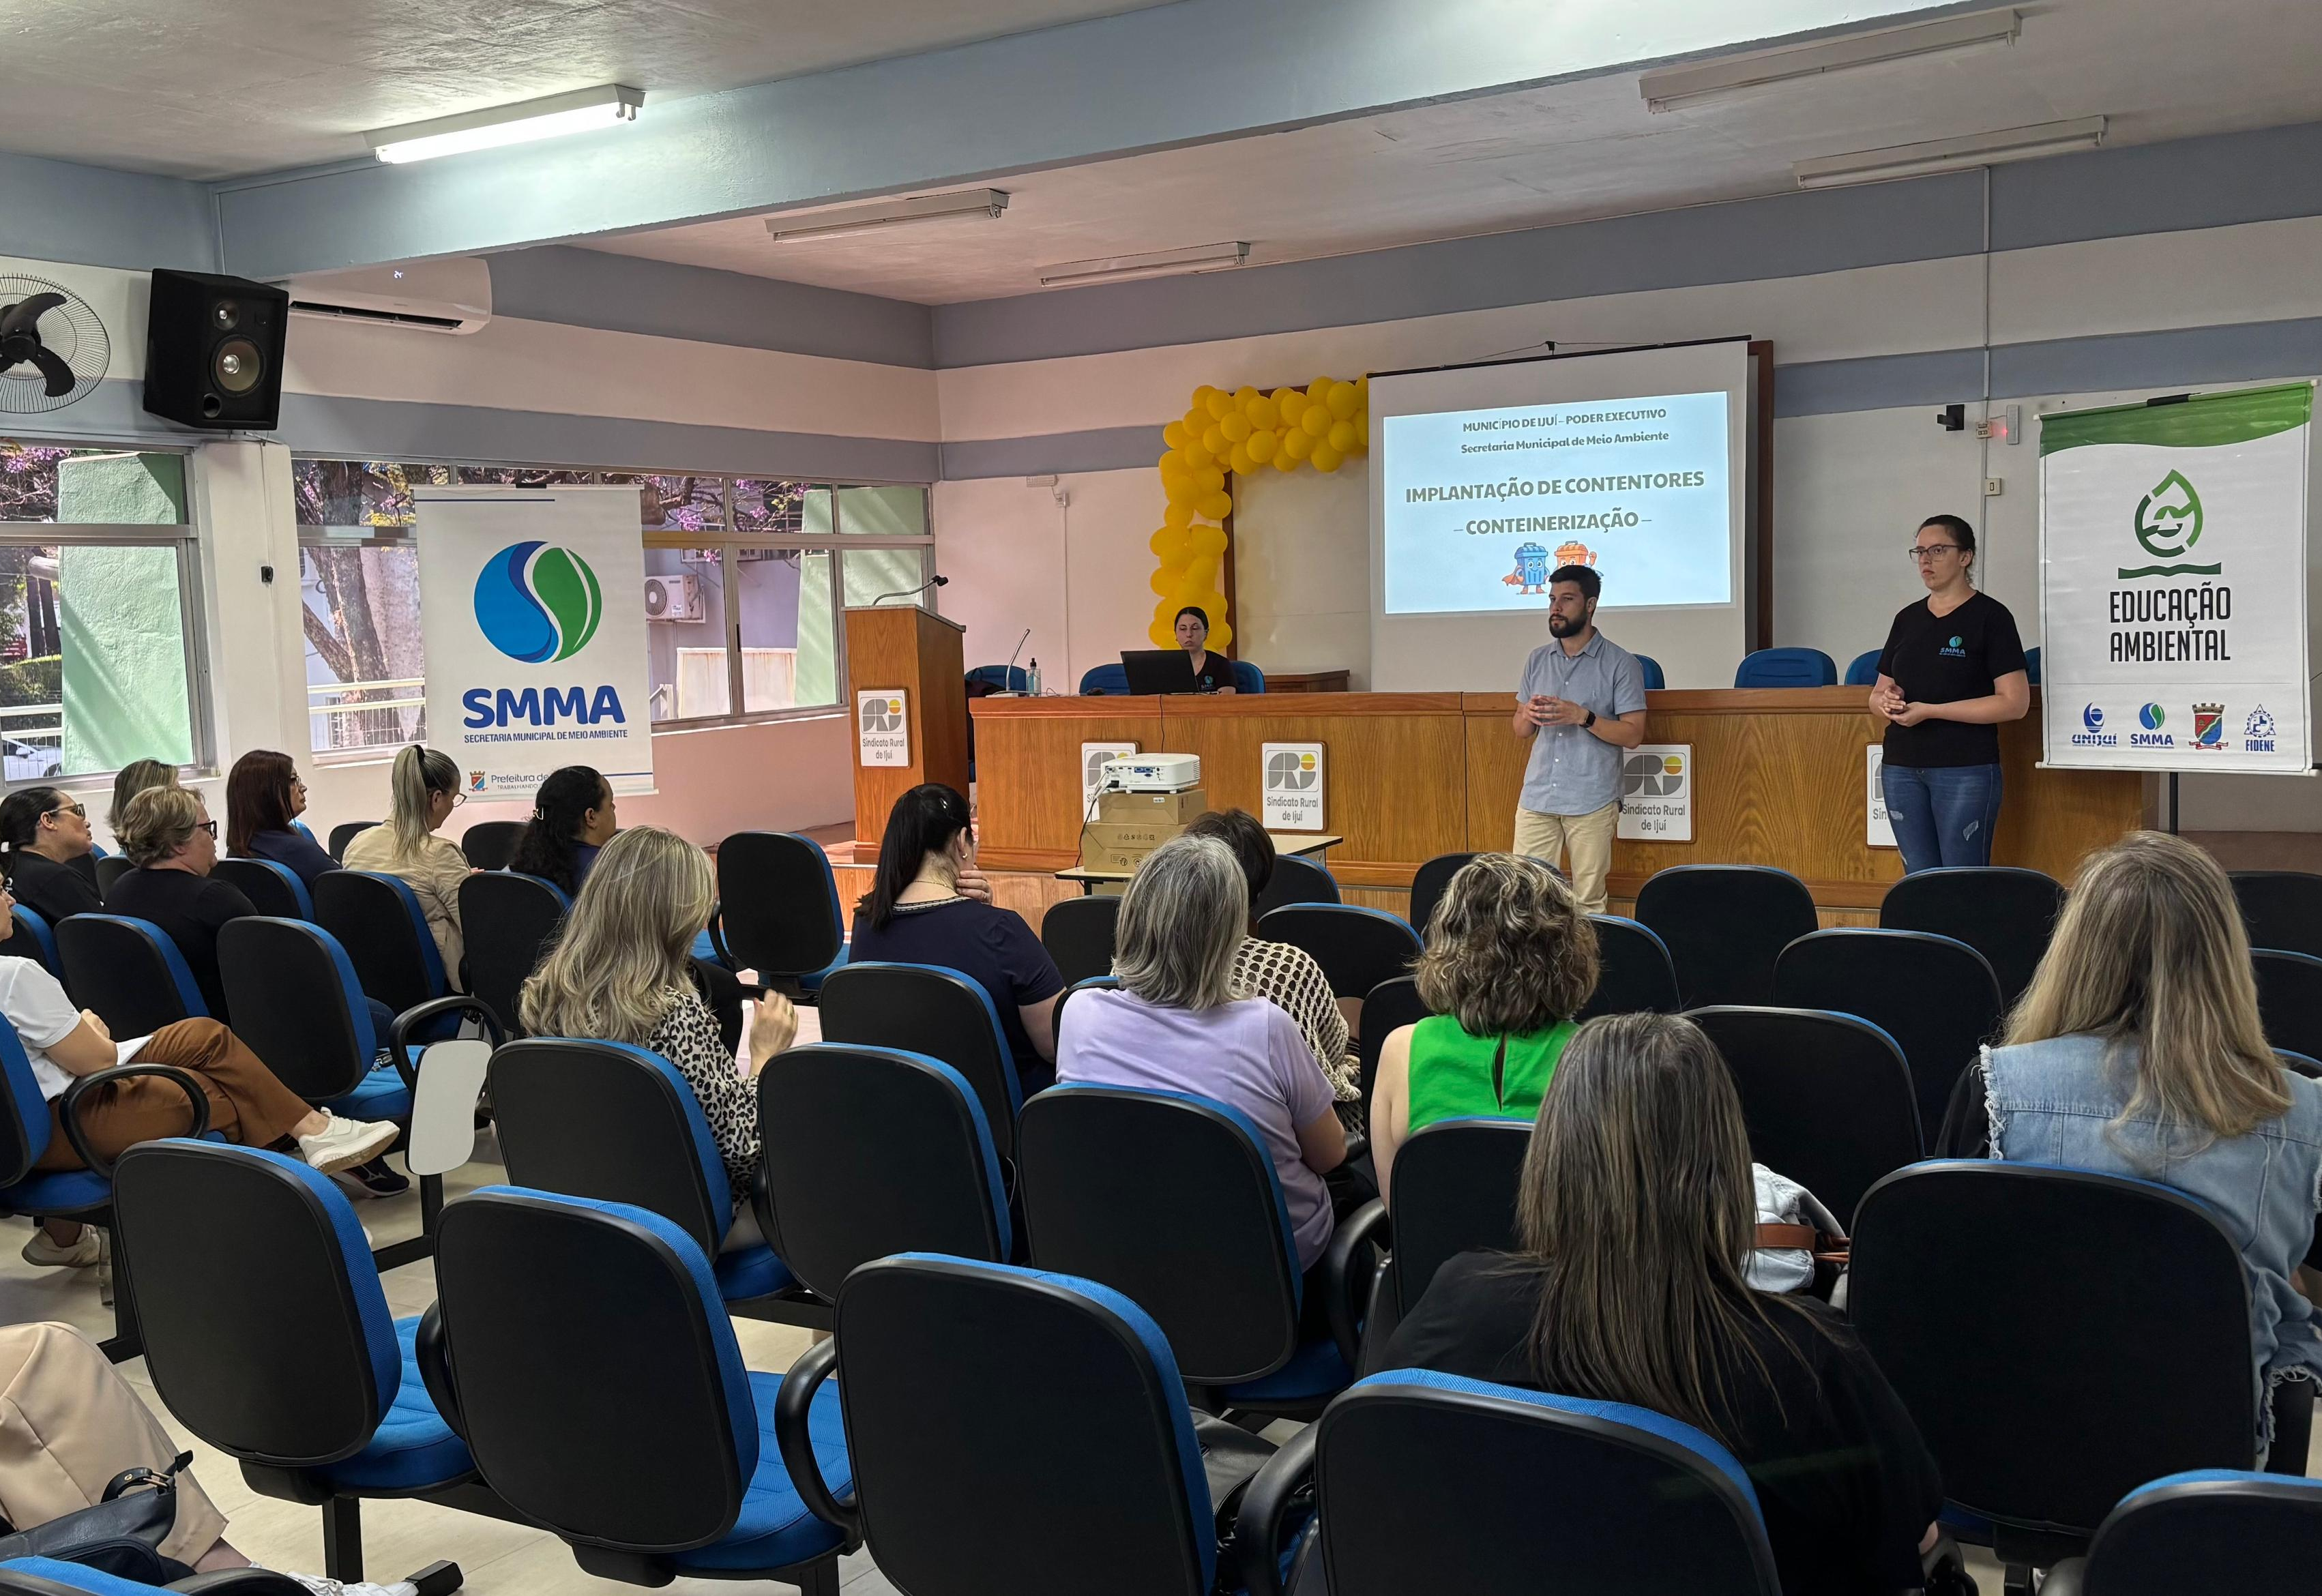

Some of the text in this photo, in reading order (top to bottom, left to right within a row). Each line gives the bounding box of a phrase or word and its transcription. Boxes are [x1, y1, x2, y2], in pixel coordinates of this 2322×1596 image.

[1463, 418, 1520, 432] MUNICÍPIO
[1522, 418, 1536, 428] DE
[1538, 413, 1558, 427] IJUÍ
[1566, 413, 1604, 425] PODER
[1605, 409, 1666, 422] EXECUTIVO
[1461, 431, 1669, 454] Secretaria Municipal de Meio Ambiente
[1406, 471, 1705, 503] IMPLANTAÇÃO DE CONTENTORES
[1466, 507, 1638, 535] CONTEINERIZAÇÃO
[2110, 581, 2231, 629] EDUCAÇÃO
[2111, 630, 2231, 662] AMBIENTAL
[462, 685, 626, 728] SMMA
[465, 729, 628, 743] SECRETARIA MUNICIPAL DE MEIO AMBIENTE
[862, 737, 905, 748] Sindicato Rural
[2130, 733, 2174, 745] SMMA
[2246, 739, 2275, 752] FIDENE
[876, 750, 892, 761] de Ijuí
[491, 773, 535, 784] Prefeitura
[1267, 796, 1319, 808] Sindicato Rural
[1282, 810, 1303, 823] de Ijuí
[1622, 803, 1686, 816] Sindicato Rural
[1641, 818, 1666, 833] de Ijuí
